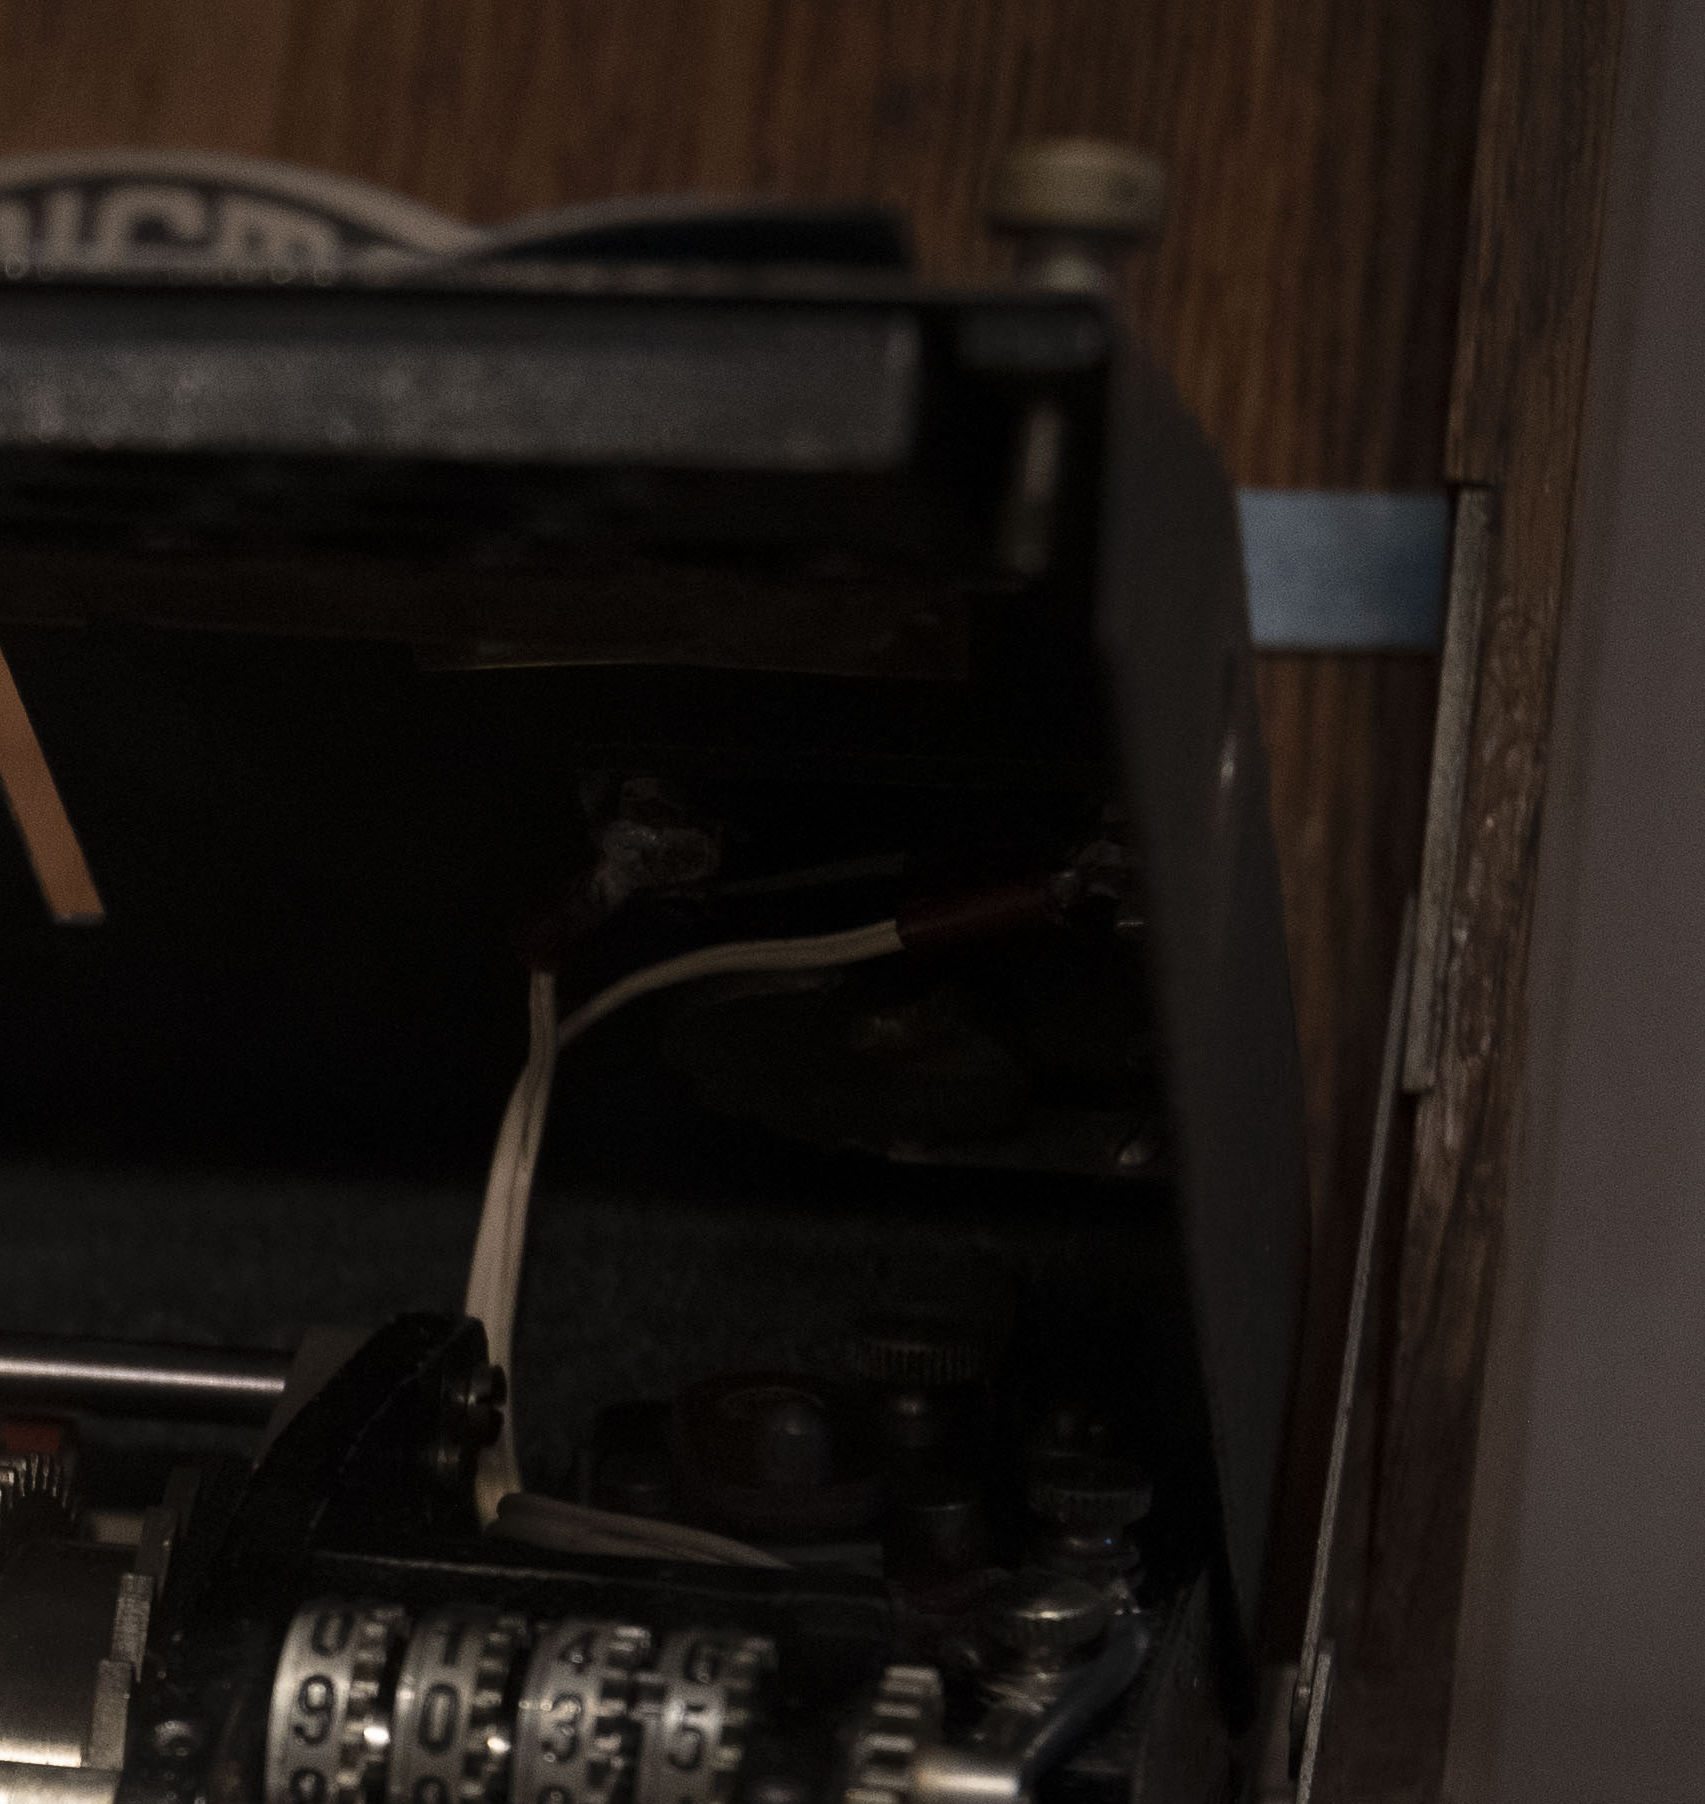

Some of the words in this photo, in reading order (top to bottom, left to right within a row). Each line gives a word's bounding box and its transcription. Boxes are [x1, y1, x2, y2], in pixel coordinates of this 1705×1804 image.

[293, 1674, 334, 1744] 9
[419, 1683, 460, 1753] 0
[541, 1692, 584, 1762] 3
[668, 1701, 708, 1771] 5
